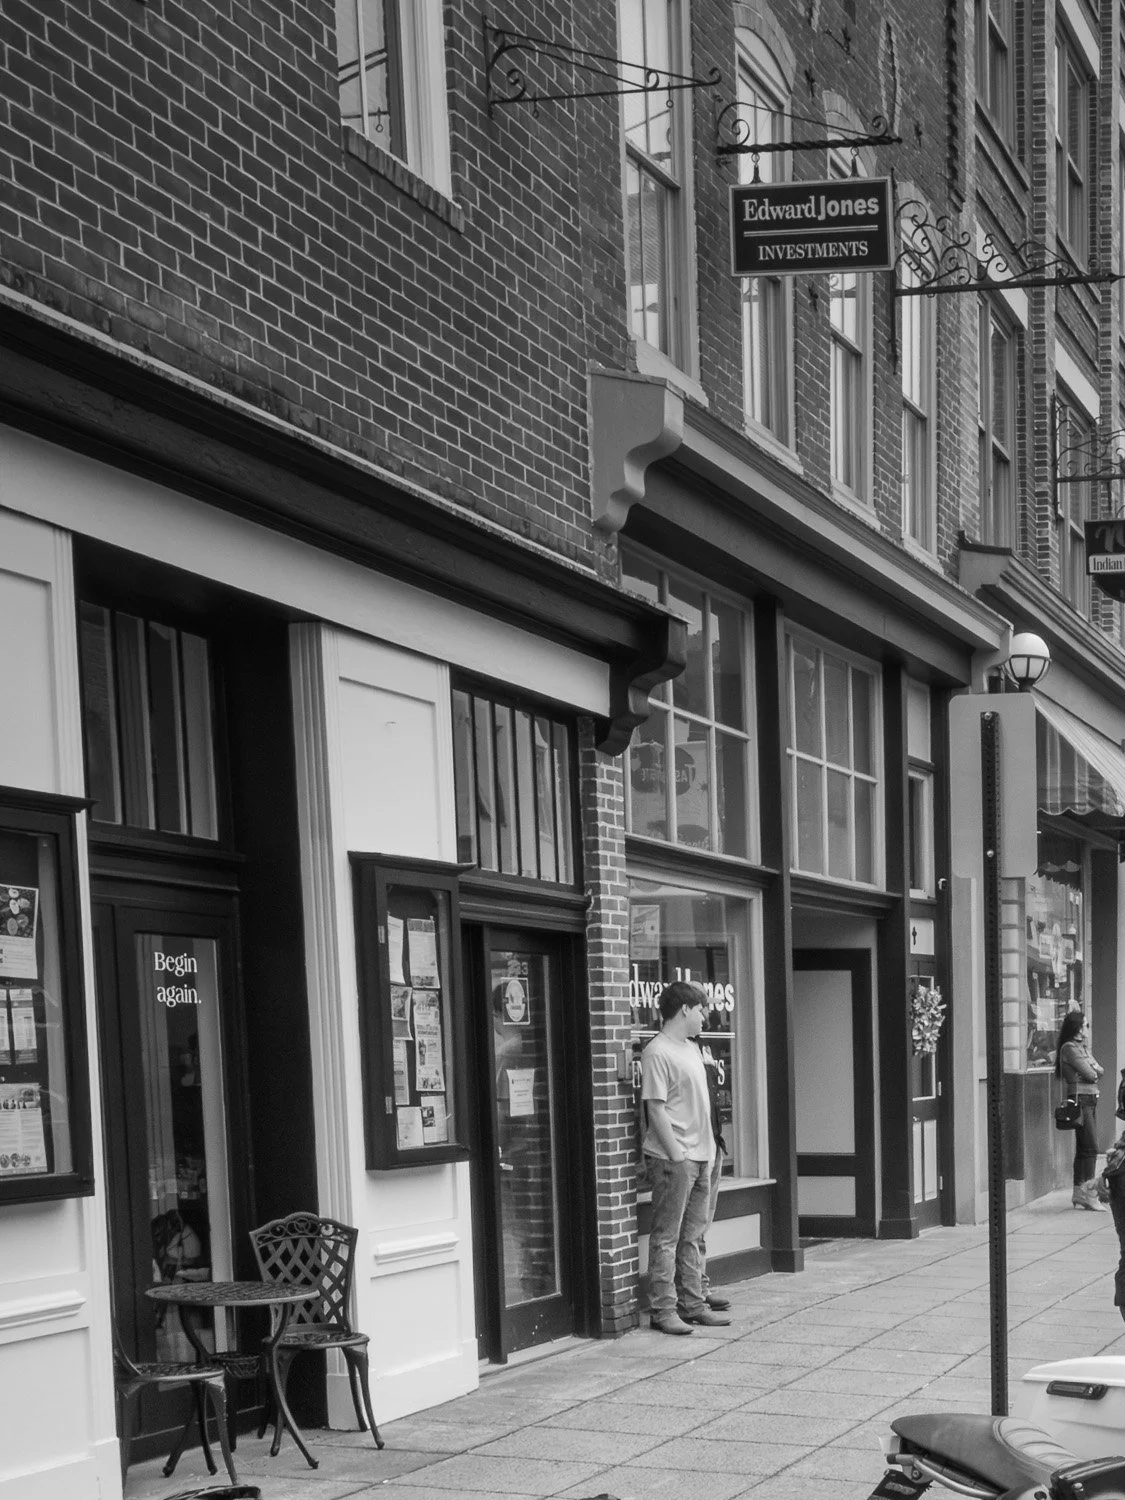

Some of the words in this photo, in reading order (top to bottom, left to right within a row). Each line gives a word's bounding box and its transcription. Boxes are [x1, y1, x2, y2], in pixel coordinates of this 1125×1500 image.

[743, 195, 816, 222] Edward
[817, 195, 880, 221] Jones
[758, 240, 869, 261] INVESTMENTS
[1093, 556, 1123, 571] Indian
[154, 952, 198, 977] Begin
[157, 984, 202, 1008] again.
